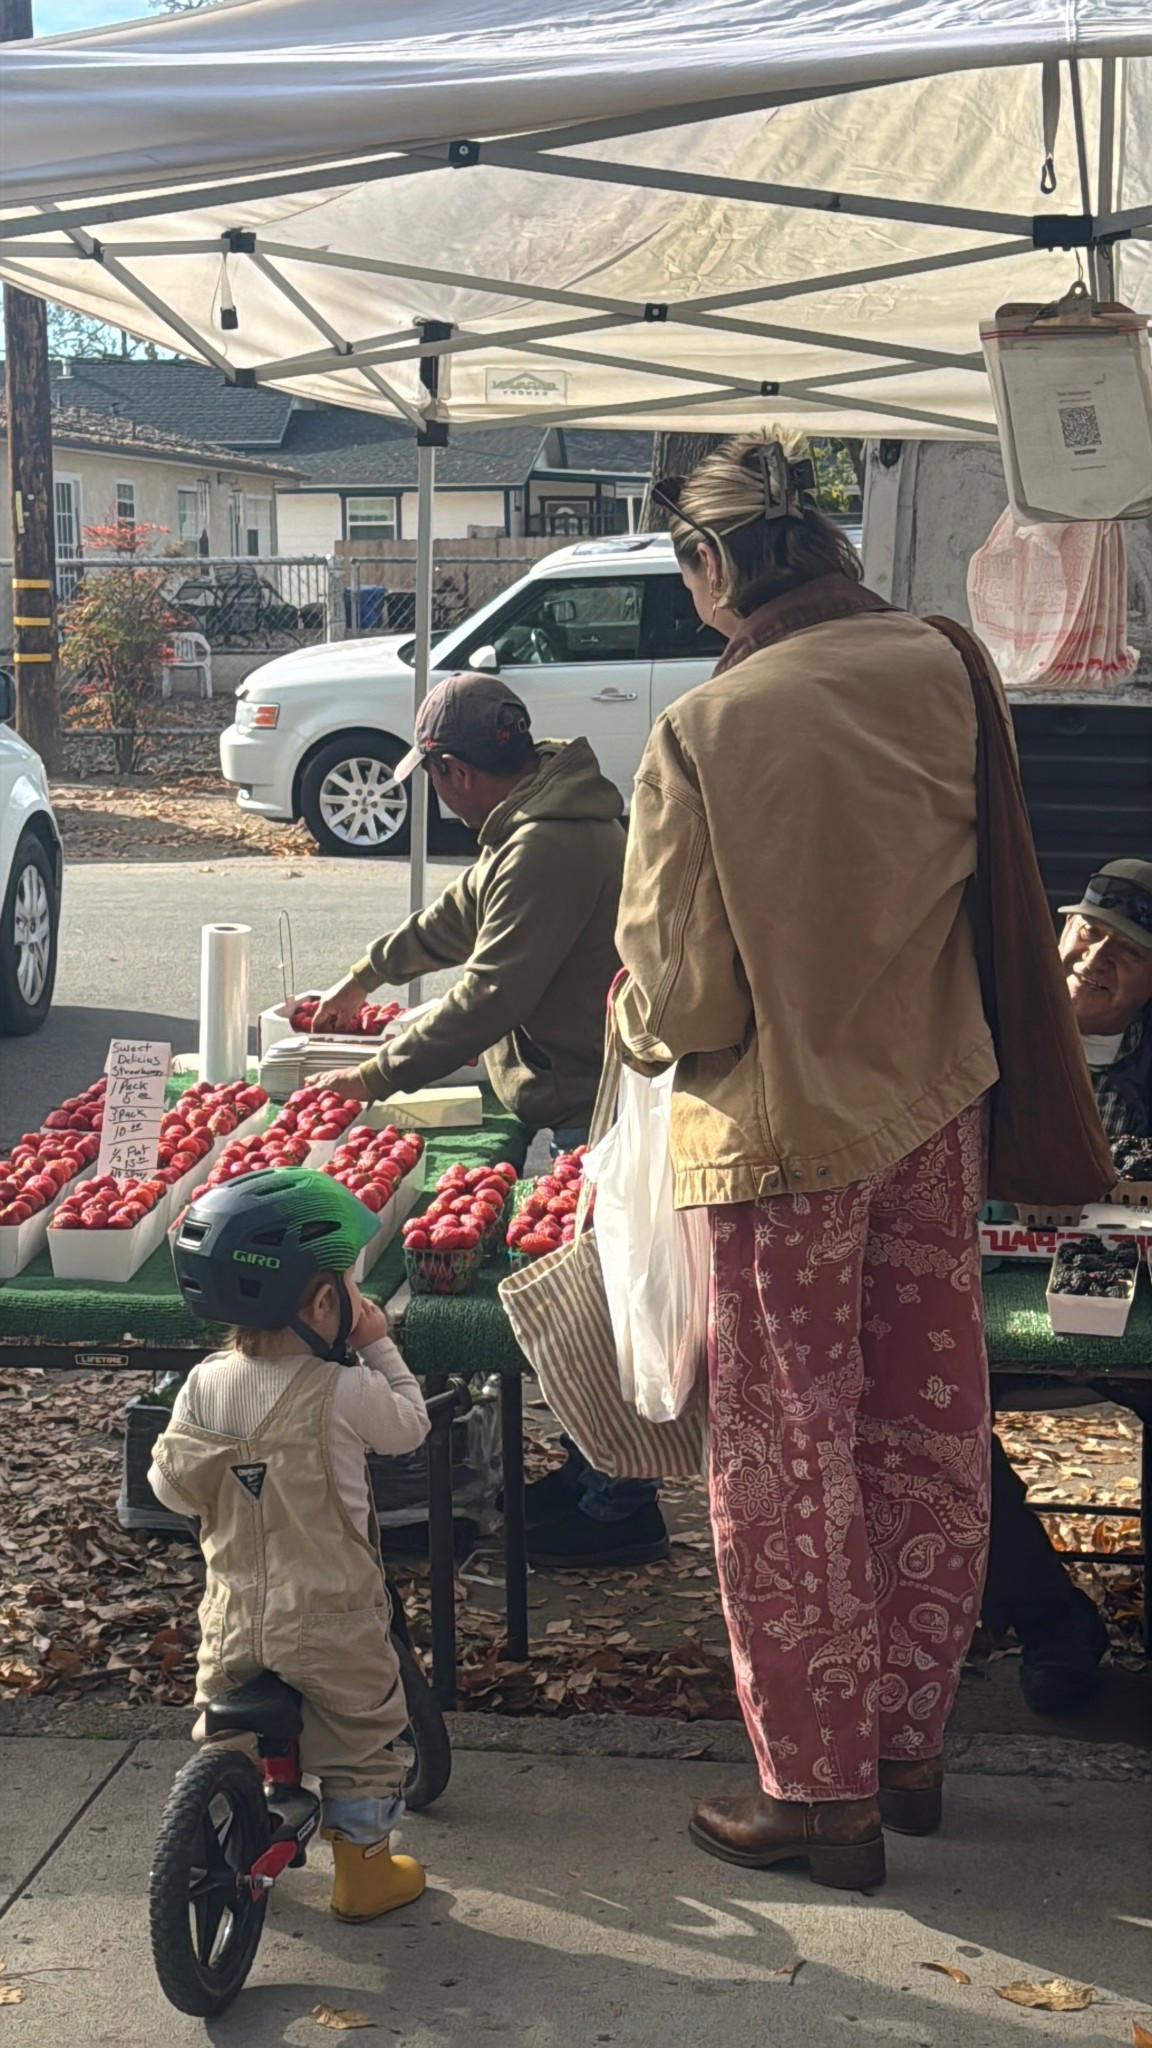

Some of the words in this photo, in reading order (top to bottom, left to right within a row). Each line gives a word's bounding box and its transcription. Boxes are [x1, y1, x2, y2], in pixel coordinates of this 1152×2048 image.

[109, 1081, 118, 1097] 1
[119, 1080, 149, 1095] Pack
[232, 1249, 281, 1269] GIRO
[81, 1355, 122, 1365] LIFETIME
